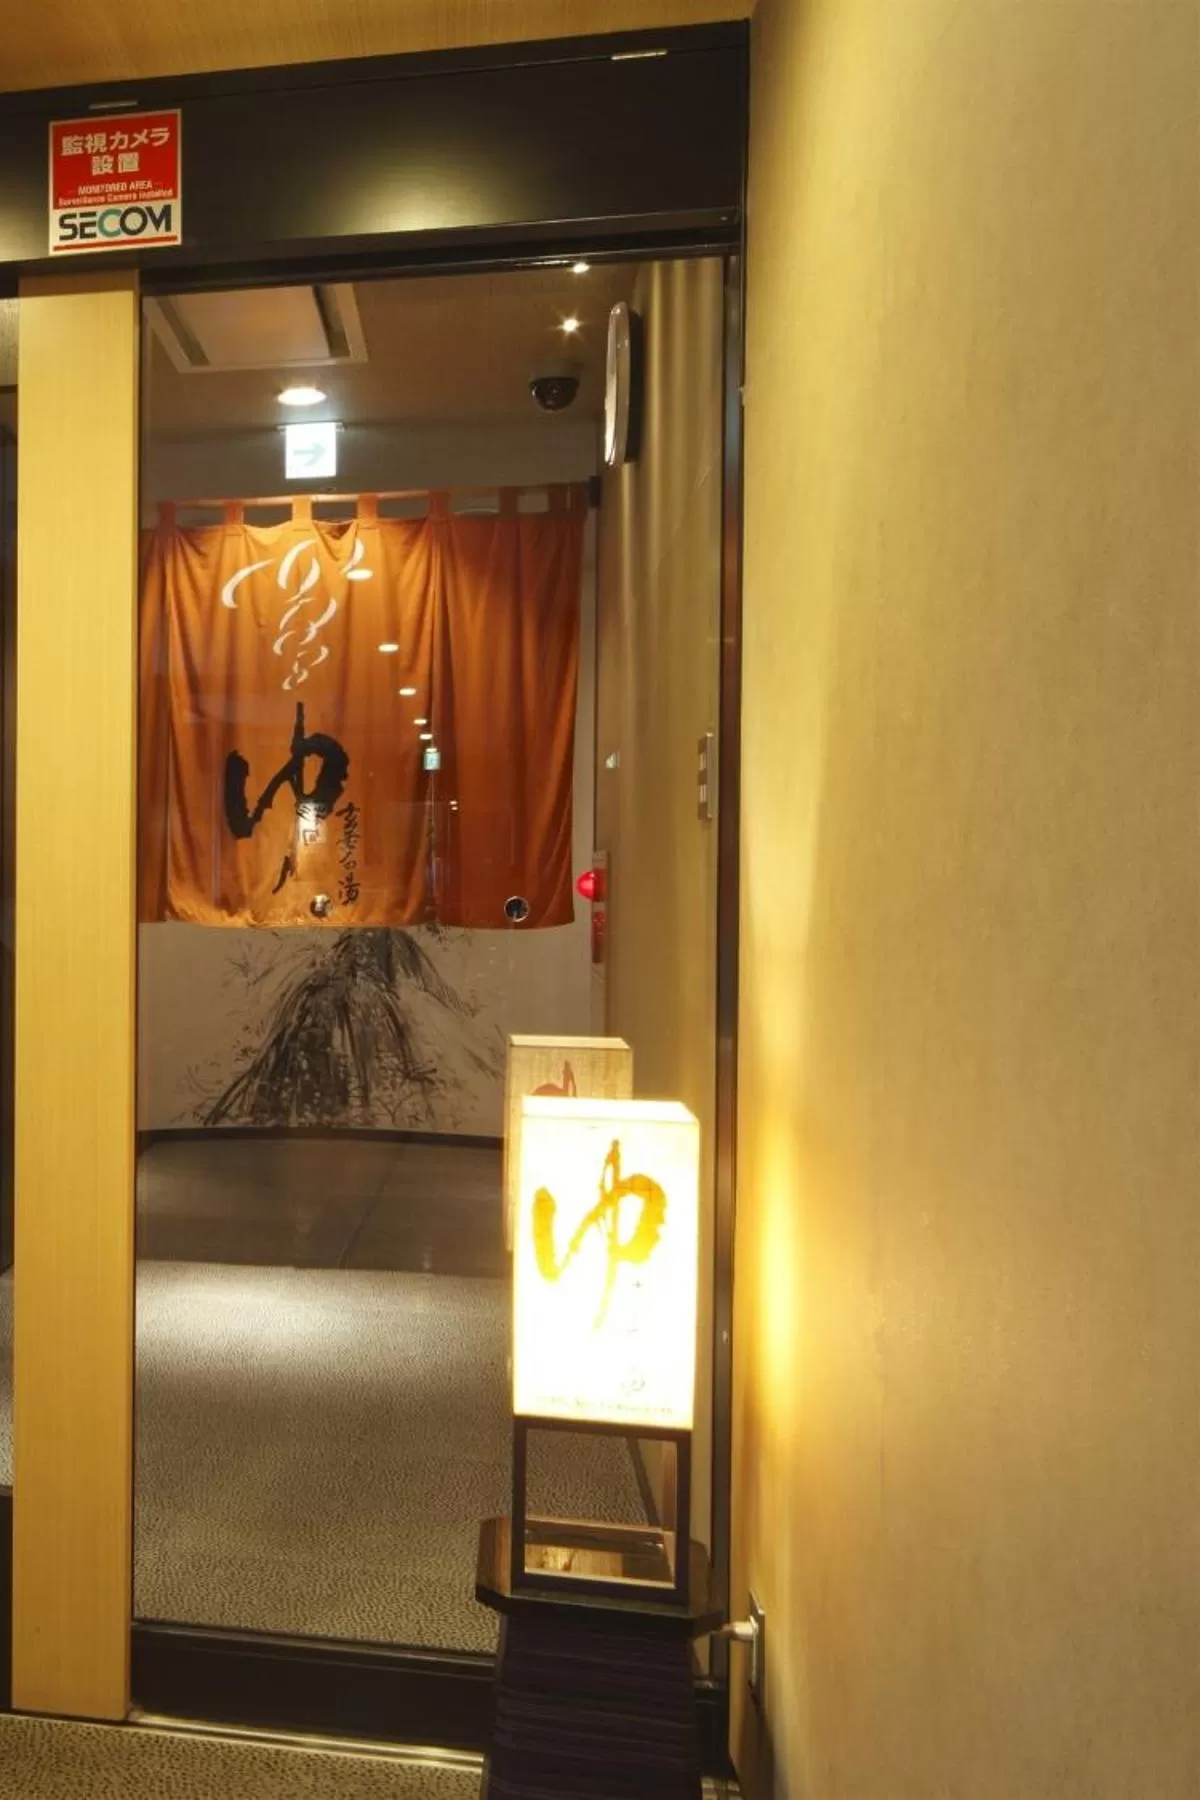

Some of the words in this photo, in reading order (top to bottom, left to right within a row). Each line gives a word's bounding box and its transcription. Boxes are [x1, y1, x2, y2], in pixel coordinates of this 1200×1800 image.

[60, 127, 170, 156] 監視カメラ
[91, 152, 140, 176] 設置
[78, 182, 128, 195] MONITORED
[129, 180, 153, 190] AREA
[107, 191, 137, 203] Camera
[59, 204, 172, 240] SECOM
[224, 702, 350, 894] ゆ
[531, 1138, 668, 1334] ゆ
